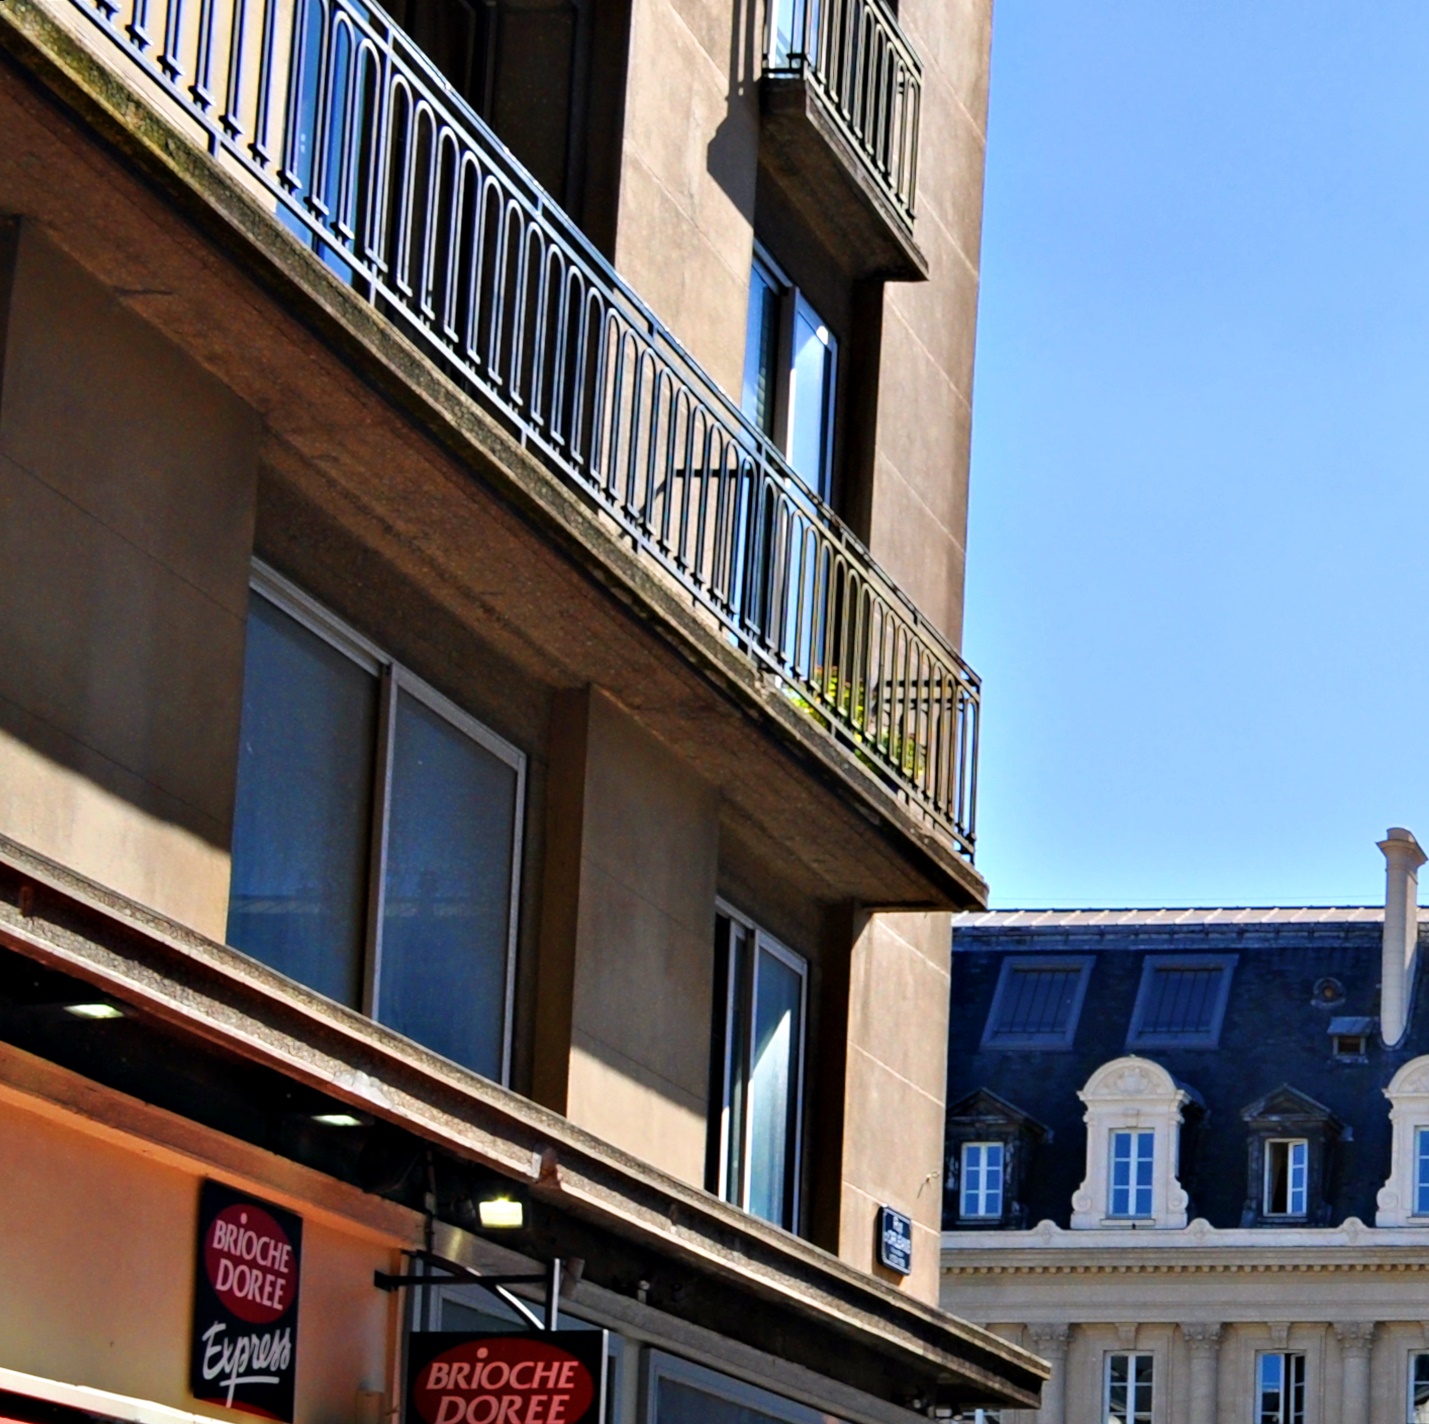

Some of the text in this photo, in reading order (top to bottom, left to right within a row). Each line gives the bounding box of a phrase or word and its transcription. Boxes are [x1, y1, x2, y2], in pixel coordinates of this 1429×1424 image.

[212, 1212, 292, 1274] BRIOCHE
[216, 1258, 286, 1312] DOREE
[201, 1320, 291, 1408] Express
[425, 1347, 579, 1390] BRIOCHE
